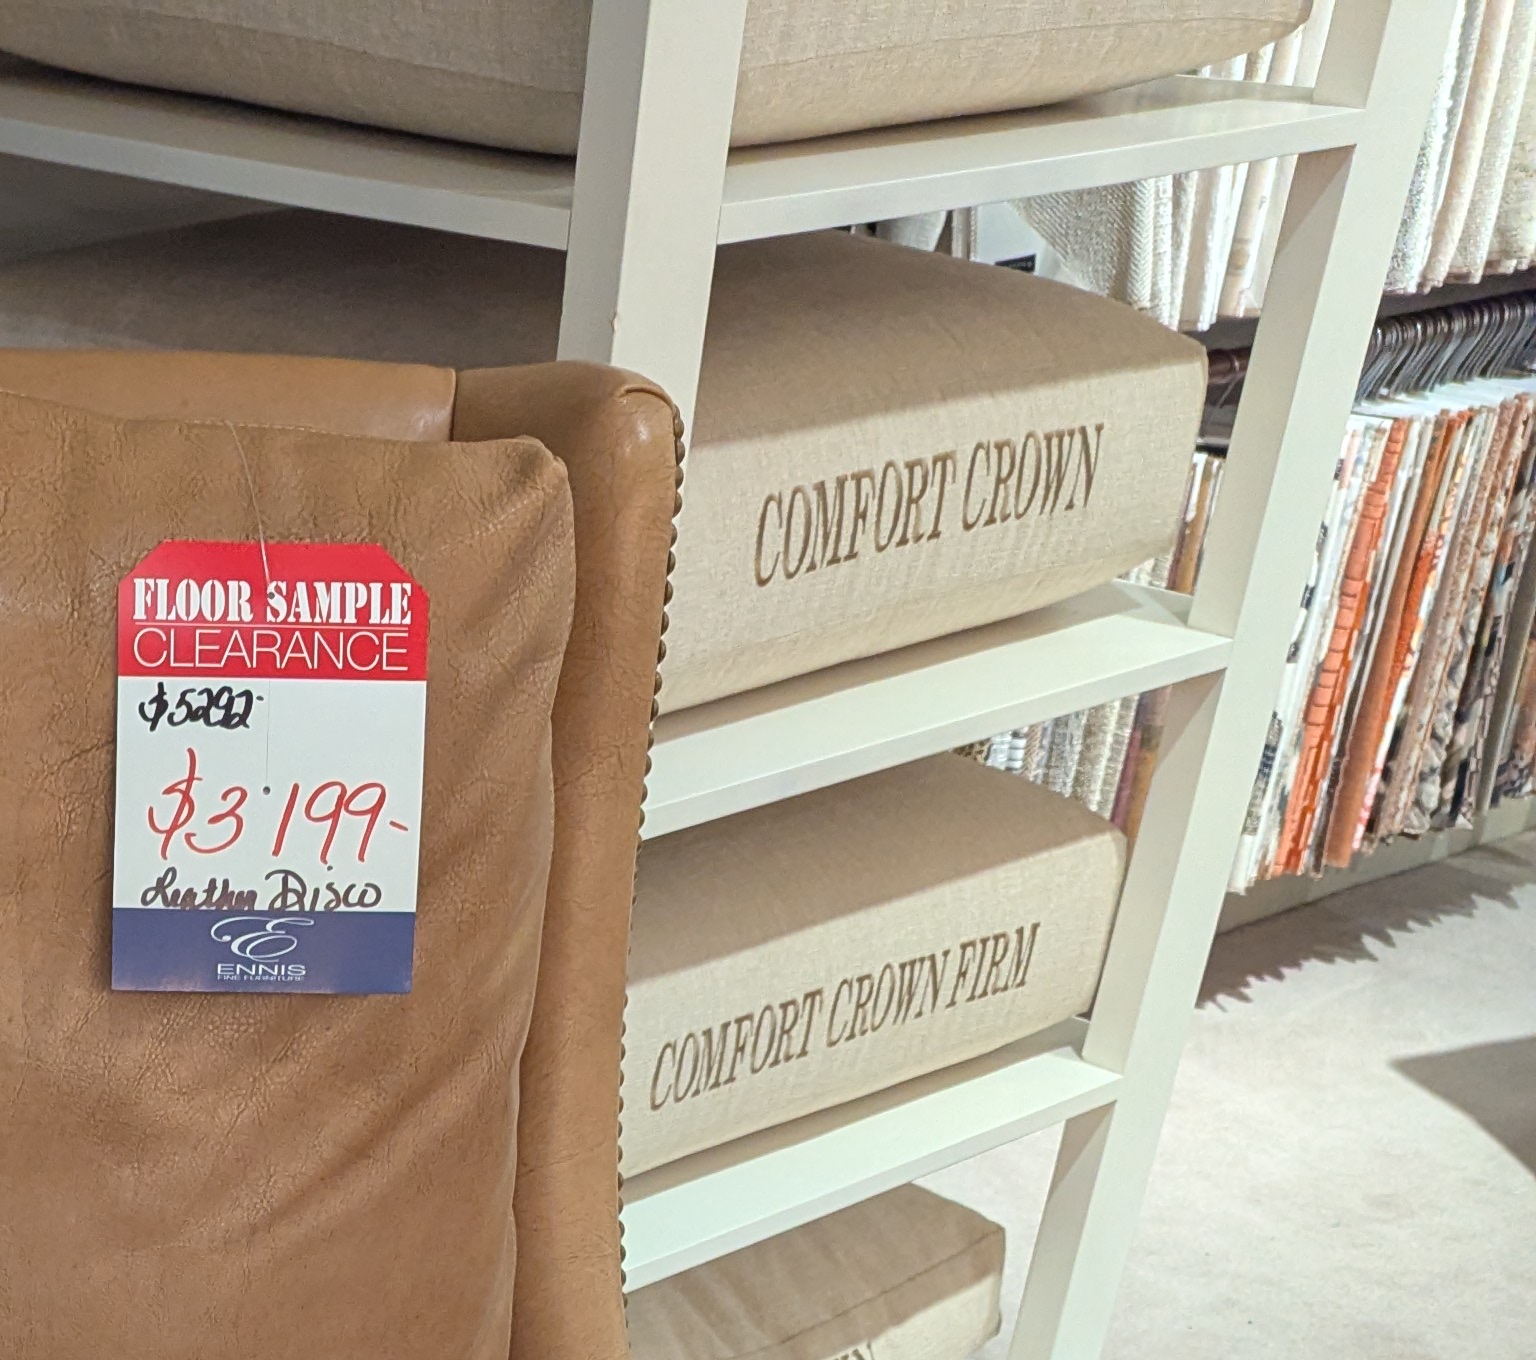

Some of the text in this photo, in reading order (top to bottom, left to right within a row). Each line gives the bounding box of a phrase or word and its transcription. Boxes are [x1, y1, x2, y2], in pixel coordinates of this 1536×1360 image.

[754, 422, 1104, 587] COMFORT CROWN
[133, 578, 411, 625] FLOOR SAMPLE
[133, 627, 409, 671] CLEARANCE
[217, 963, 306, 976] ENNIS
[650, 922, 1041, 1112] COMFORT CROWN FIRM
